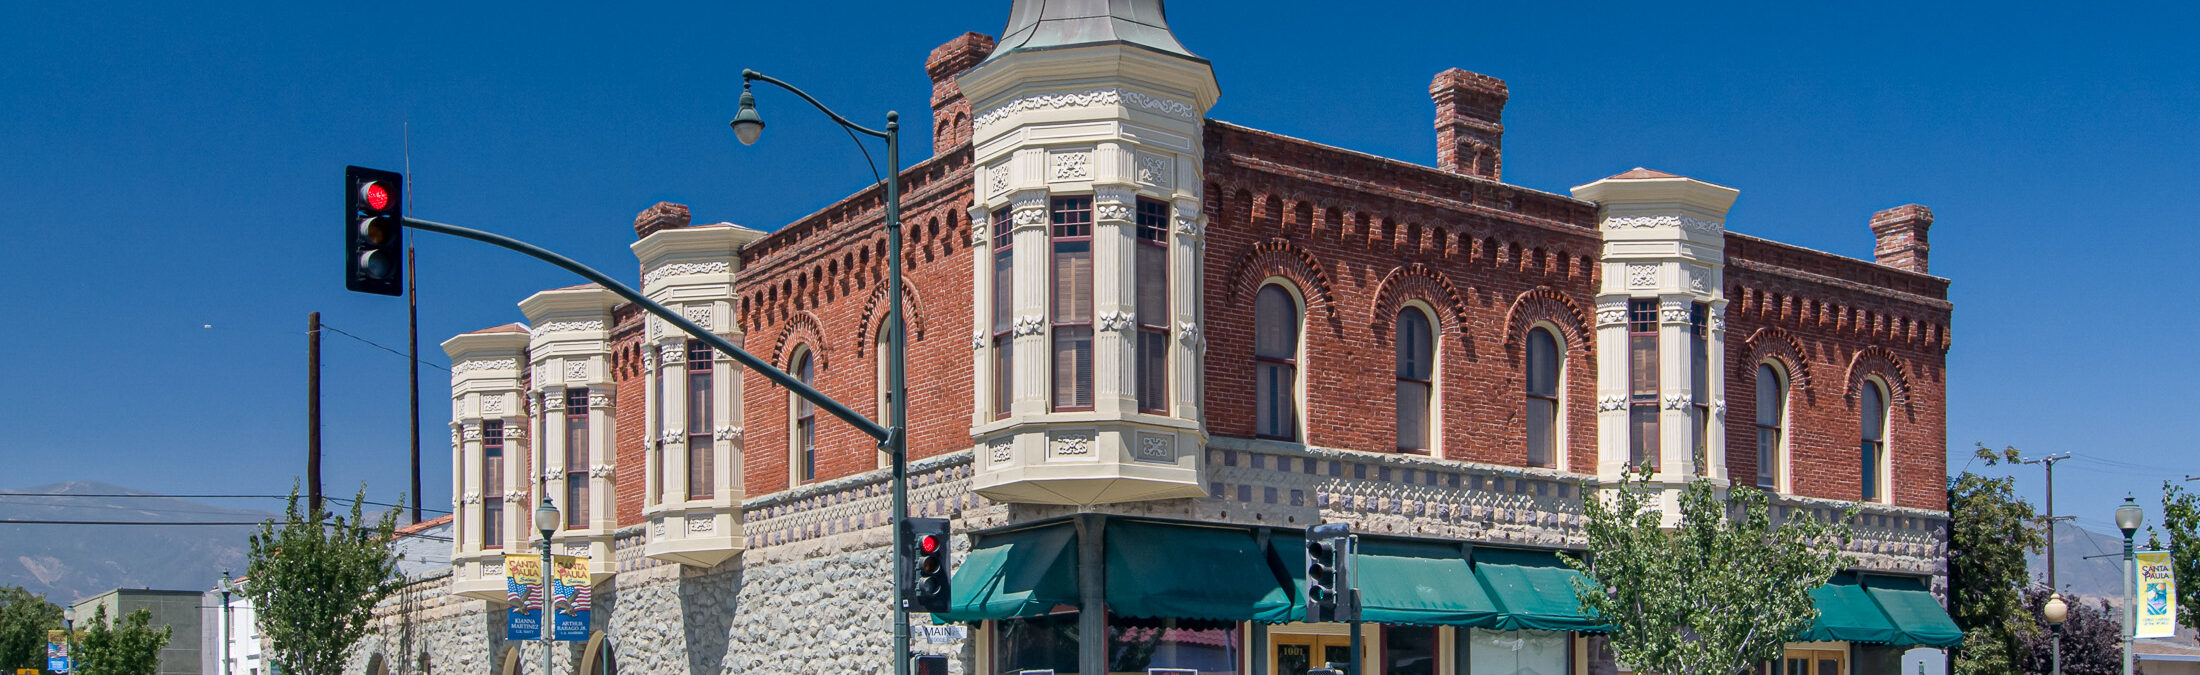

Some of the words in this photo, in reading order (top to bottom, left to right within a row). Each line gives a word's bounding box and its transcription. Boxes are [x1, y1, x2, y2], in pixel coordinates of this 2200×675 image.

[509, 560, 539, 569] SANTA
[557, 561, 587, 571] SANTA
[510, 566, 539, 577] PAULA
[557, 568, 588, 580] PAULA
[2142, 571, 2170, 581] PAULA
[925, 627, 951, 636] MAIN
[1283, 647, 1304, 656] 1001
